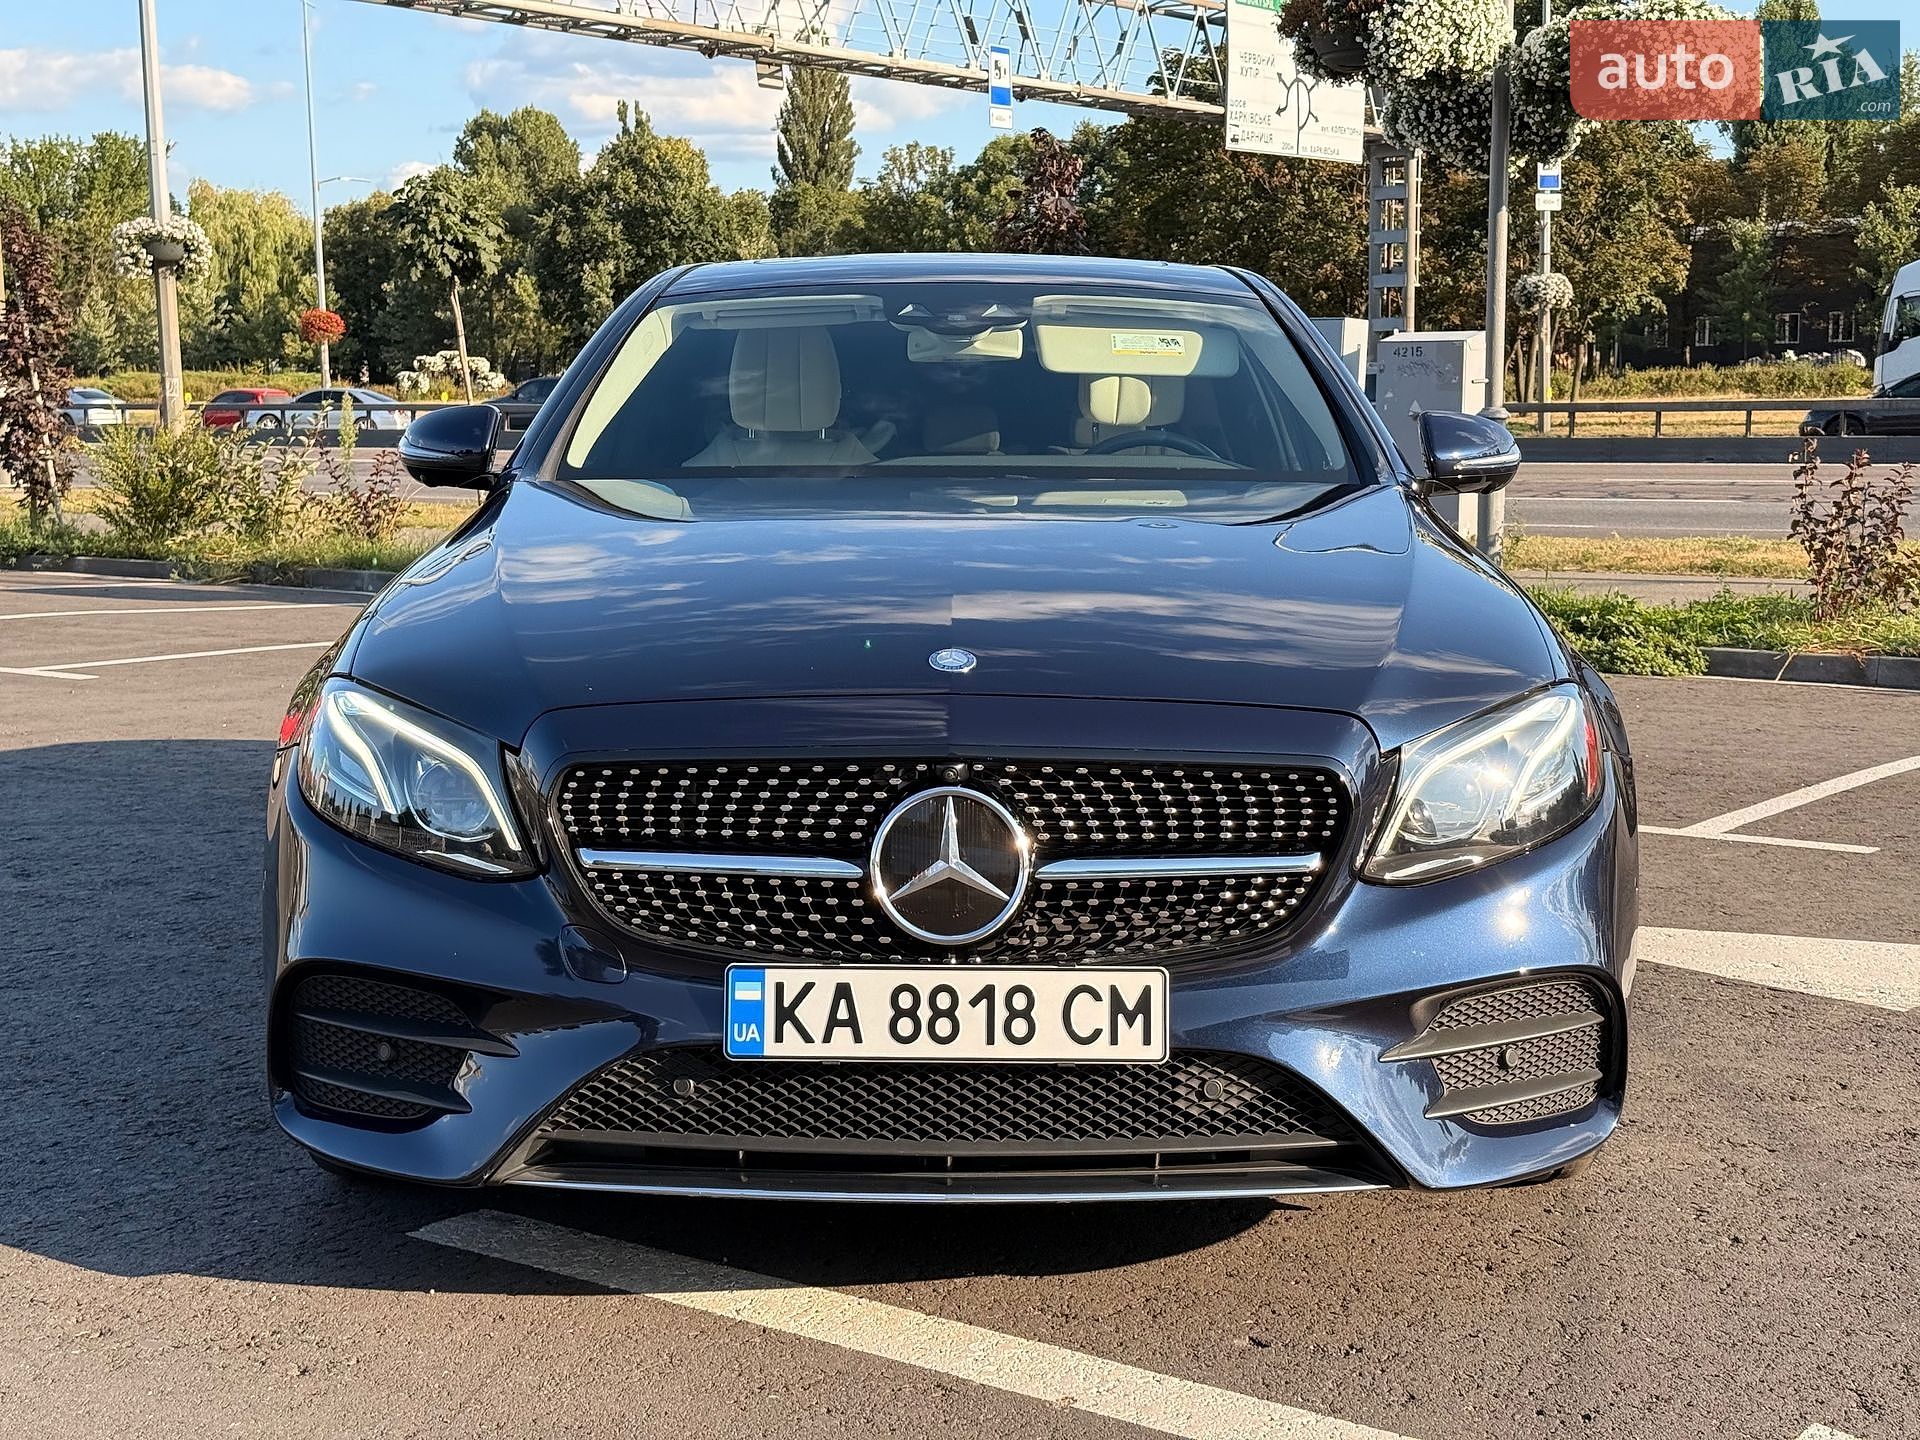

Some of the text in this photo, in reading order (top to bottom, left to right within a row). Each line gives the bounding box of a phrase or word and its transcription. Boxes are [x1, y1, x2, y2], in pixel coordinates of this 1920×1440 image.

[1239, 51, 1275, 67] ЧЕРВОНИЙ
[1229, 110, 1272, 126] ХАРКІВСЬКЕ
[1240, 129, 1273, 144] ДАРНИЦЯ
[1393, 346, 1423, 358] 4215
[774, 981, 1152, 1046] KA 8818 CM
[734, 1023, 761, 1042] UA
